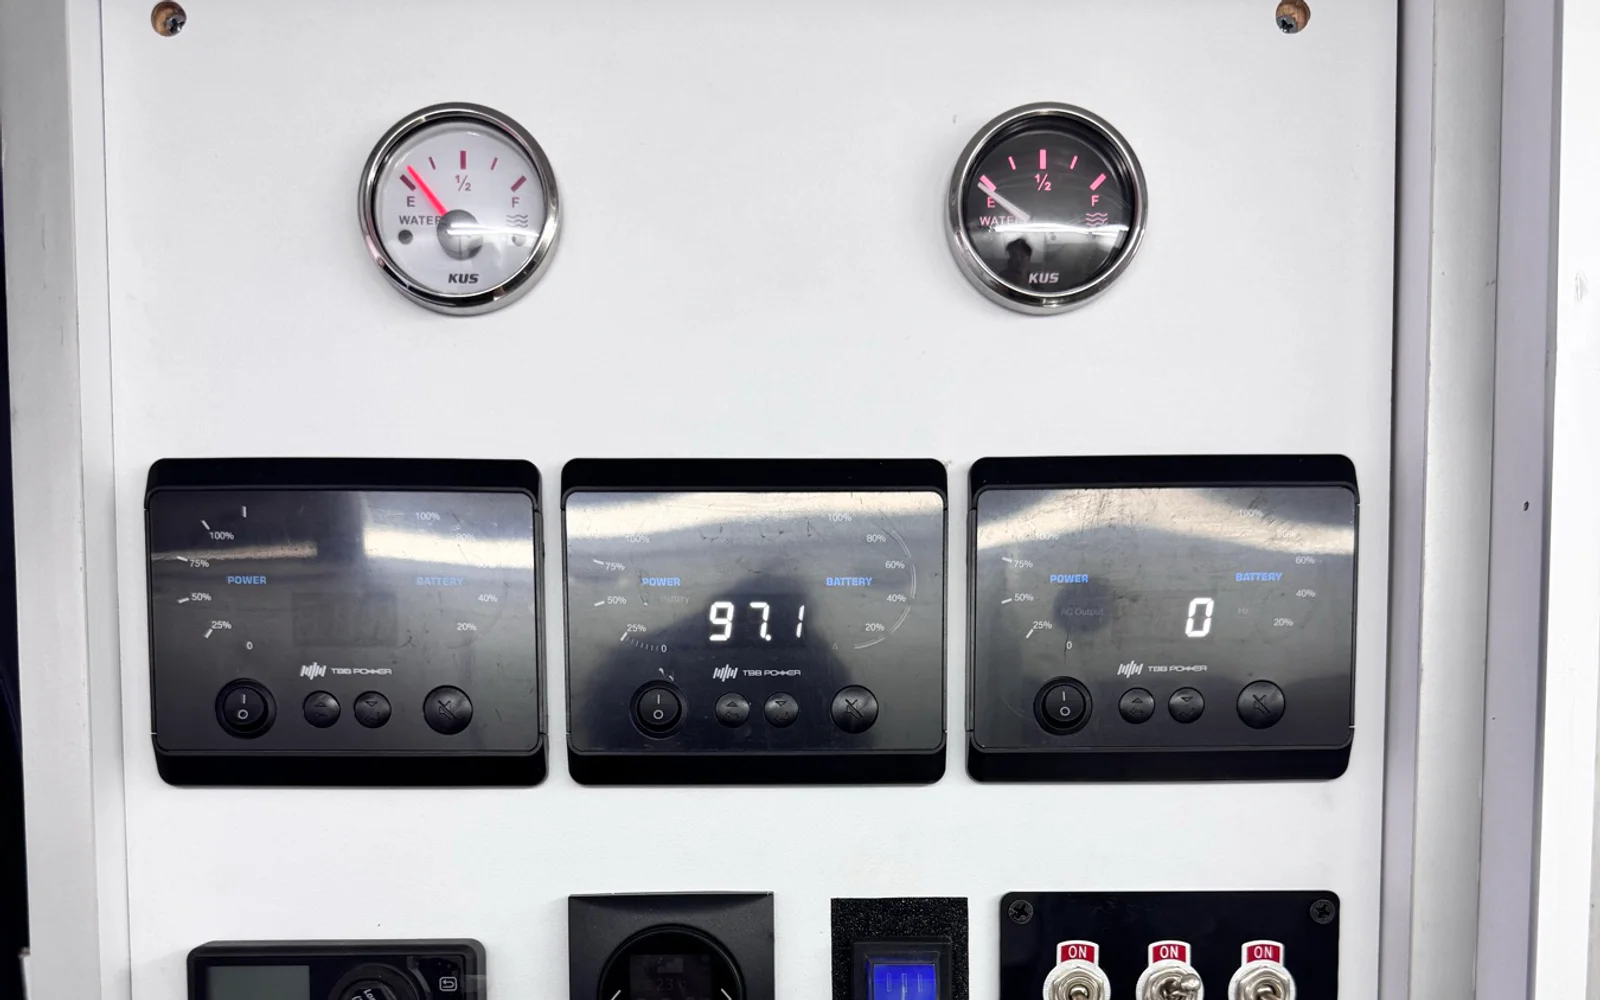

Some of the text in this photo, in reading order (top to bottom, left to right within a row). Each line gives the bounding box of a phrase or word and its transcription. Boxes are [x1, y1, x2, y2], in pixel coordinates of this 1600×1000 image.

[407, 196, 416, 207] E
[512, 197, 520, 208] F
[987, 197, 996, 208] E
[1091, 195, 1099, 207] F
[448, 273, 479, 283] KUS
[1029, 273, 1060, 284] KUS
[415, 511, 441, 521] 100%
[827, 513, 853, 522] 100%
[209, 531, 235, 541] 100%
[866, 534, 887, 543] 80%
[189, 559, 210, 568] 75%
[884, 560, 906, 569] 60%
[1013, 559, 1034, 568] 75%
[1295, 555, 1316, 565] 60%
[604, 561, 626, 571] 75%
[227, 576, 267, 585] POWER
[416, 576, 464, 586] BATTERY
[641, 577, 681, 587] POWER
[826, 577, 873, 587] BATTERY
[1049, 574, 1090, 584] POWER
[1235, 572, 1283, 582] BATTERY
[191, 592, 212, 602] 50%
[477, 593, 498, 603] 40%
[886, 593, 907, 603] 40%
[1014, 592, 1035, 602] 50%
[1295, 588, 1316, 598] 40%
[607, 595, 627, 605] 50%
[1185, 597, 1215, 638] 0
[1273, 617, 1294, 627] 20%
[211, 620, 232, 630] 25%
[456, 622, 477, 632] 20%
[626, 623, 647, 633] 25%
[864, 622, 885, 632] 20%
[1032, 620, 1053, 630] 25%
[246, 641, 254, 650] 0
[660, 644, 668, 653] 0
[1066, 641, 1073, 650] 0
[1067, 945, 1087, 959] ON
[1159, 945, 1179, 959] ON
[1253, 945, 1273, 959] ON
